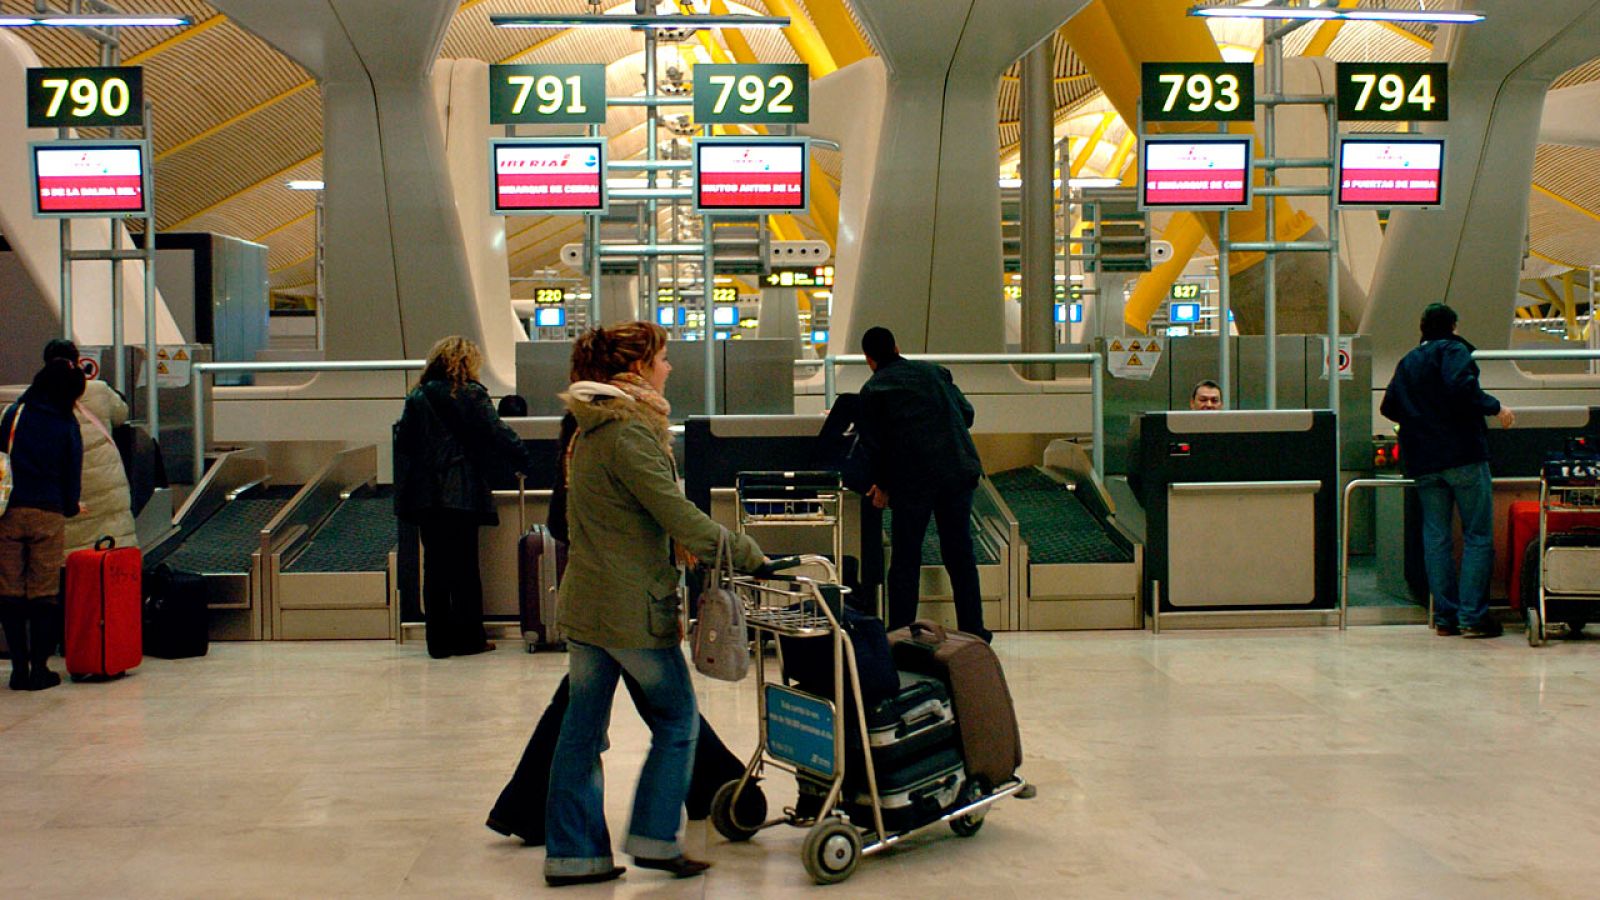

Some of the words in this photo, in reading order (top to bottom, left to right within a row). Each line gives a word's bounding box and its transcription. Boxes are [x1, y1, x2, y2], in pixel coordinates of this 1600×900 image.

[42, 78, 130, 118] 790
[507, 75, 587, 114] 791
[709, 75, 794, 114] 792
[1158, 74, 1241, 112] 793
[1350, 74, 1436, 112] 794
[537, 289, 562, 302] 220
